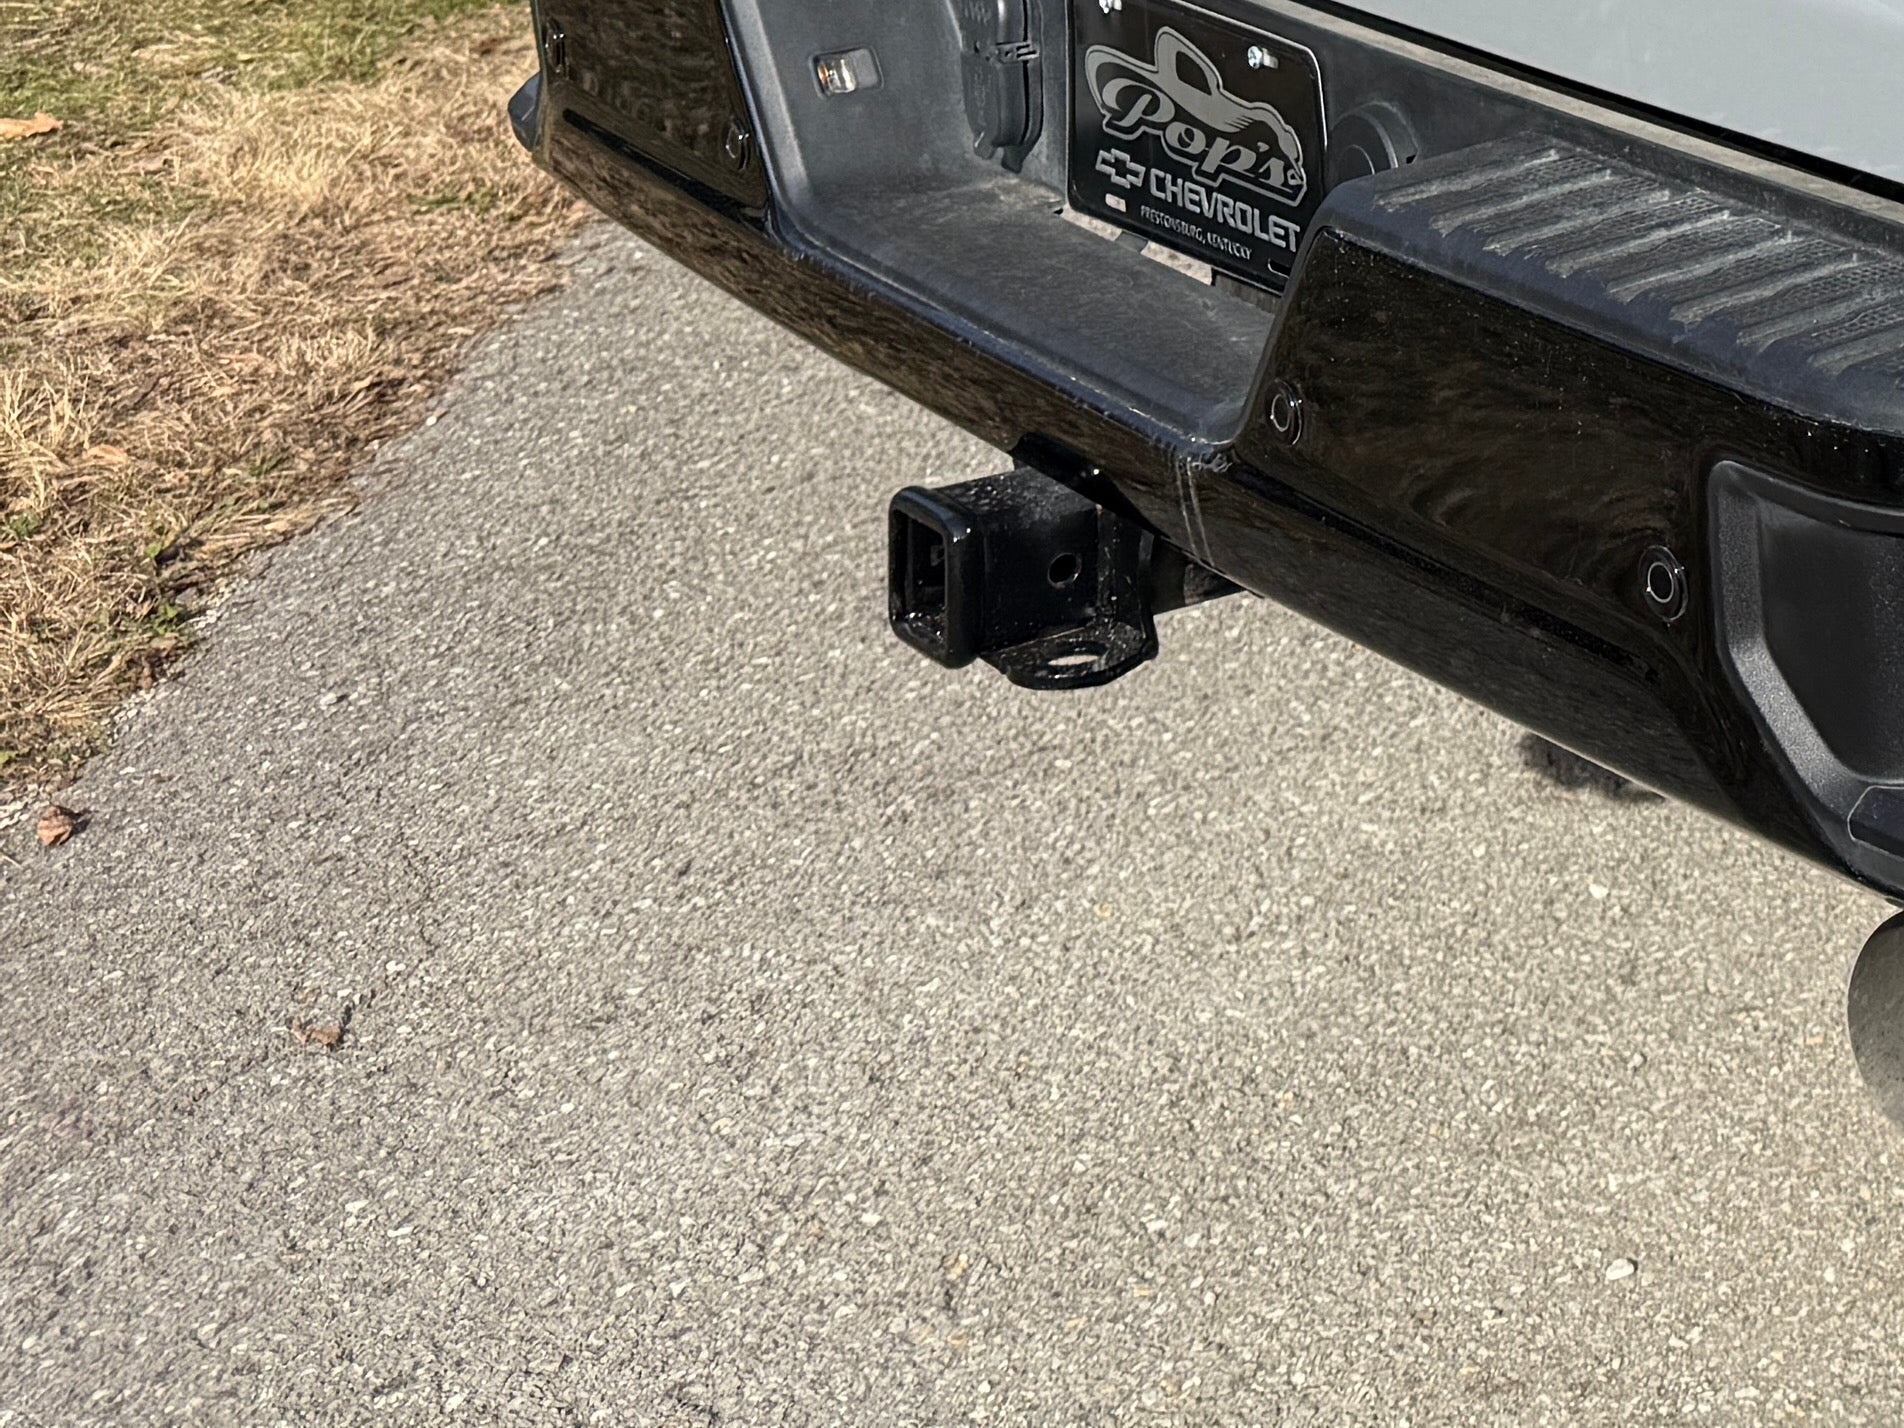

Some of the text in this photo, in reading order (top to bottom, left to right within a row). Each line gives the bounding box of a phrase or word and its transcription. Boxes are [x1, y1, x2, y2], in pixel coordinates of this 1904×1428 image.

[1101, 76, 1296, 192] Pop's
[1139, 204, 1253, 262] PRESTONSBURG, KENTUCKY
[1149, 167, 1302, 253] CHEVROLET
